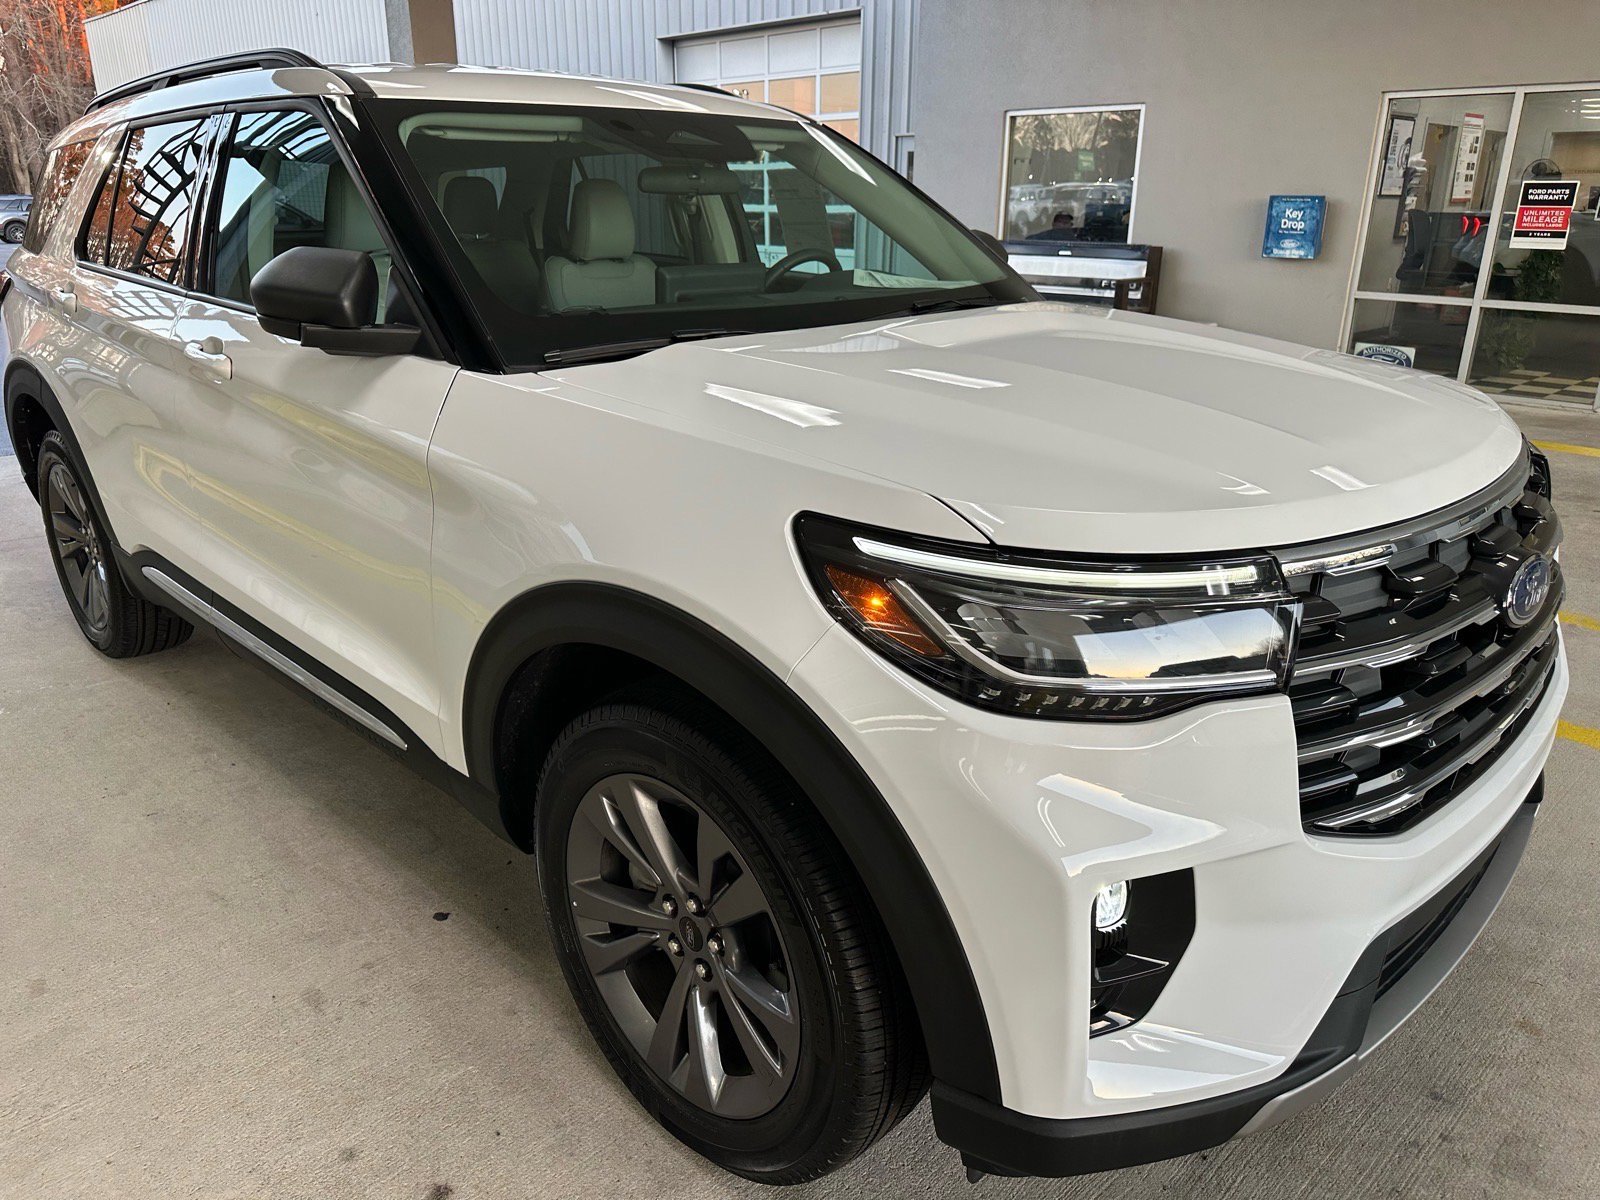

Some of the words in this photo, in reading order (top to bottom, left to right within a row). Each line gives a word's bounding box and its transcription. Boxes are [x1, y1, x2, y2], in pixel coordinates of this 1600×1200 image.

[1285, 208, 1304, 220] Key
[1281, 219, 1305, 231] Drop
[1362, 346, 1407, 360] AUTHORIZED
[1524, 566, 1549, 613] Ford
